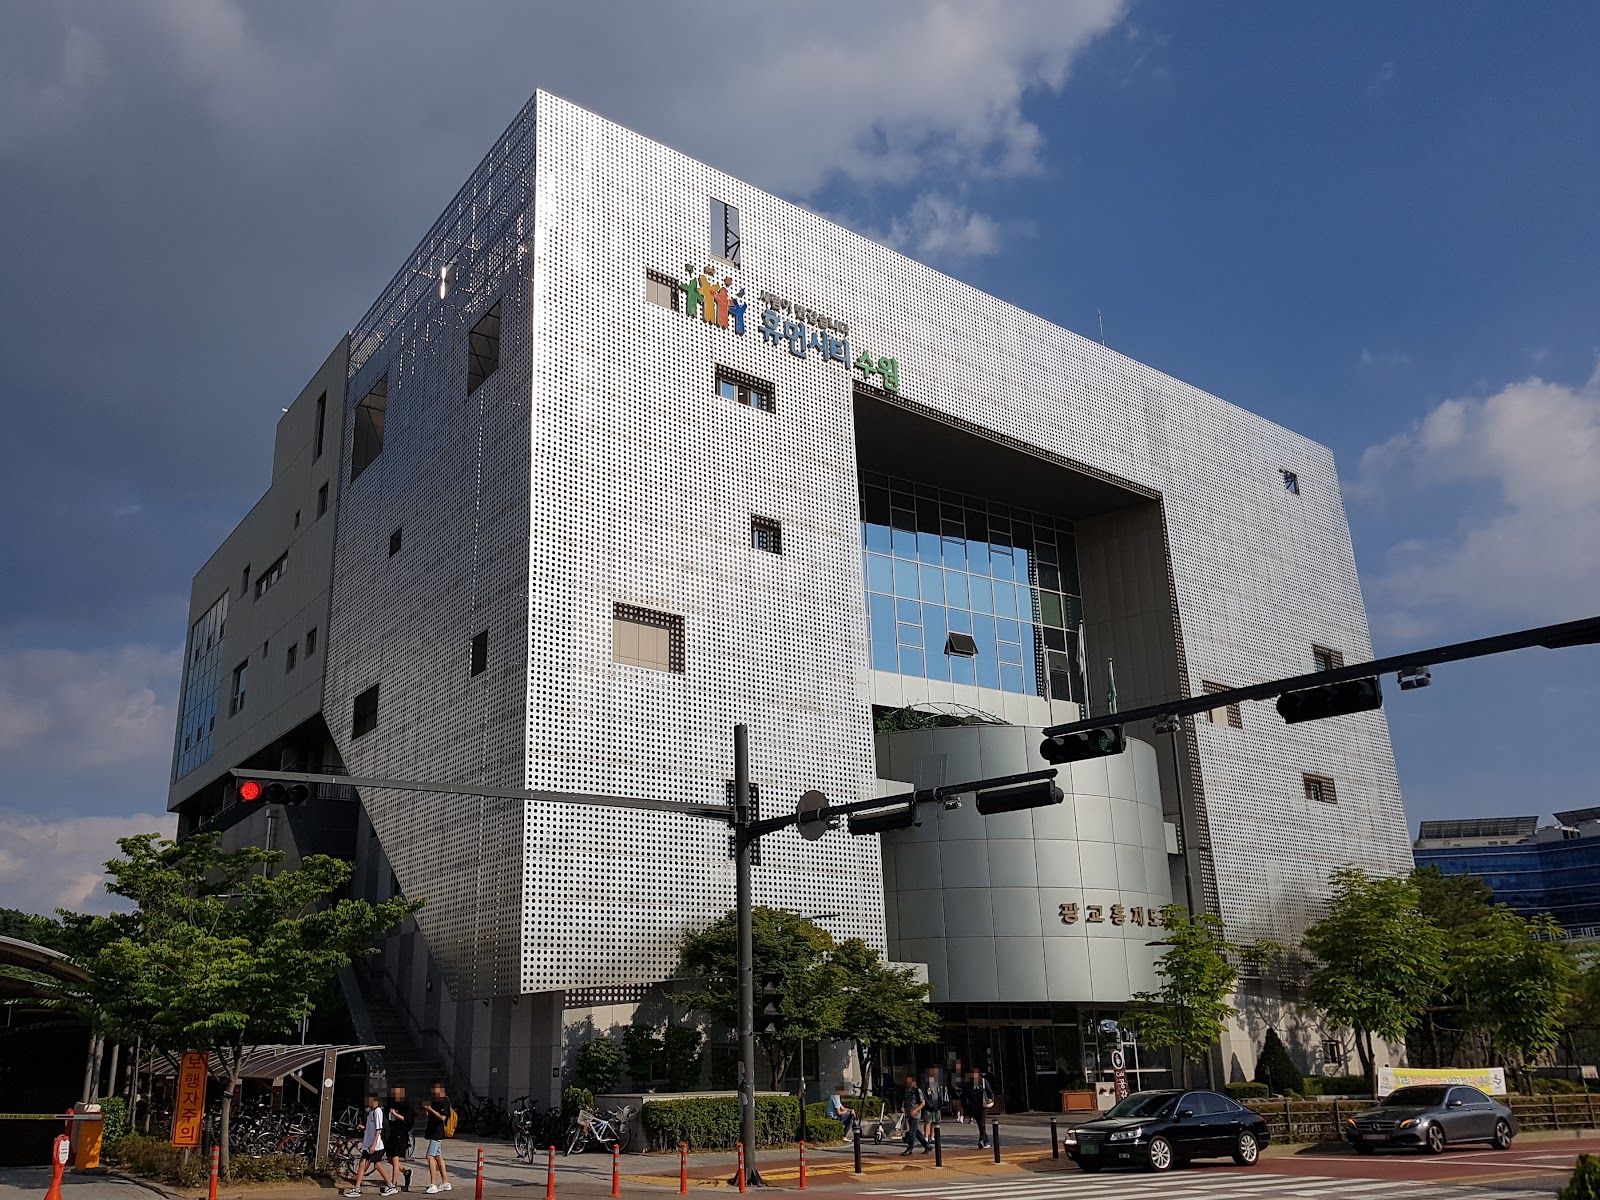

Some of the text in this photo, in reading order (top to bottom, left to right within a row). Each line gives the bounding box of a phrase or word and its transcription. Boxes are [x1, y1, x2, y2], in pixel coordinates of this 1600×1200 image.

[757, 289, 850, 336] 사람이 반갑습니다
[758, 309, 900, 392] 휴먼시티 수원
